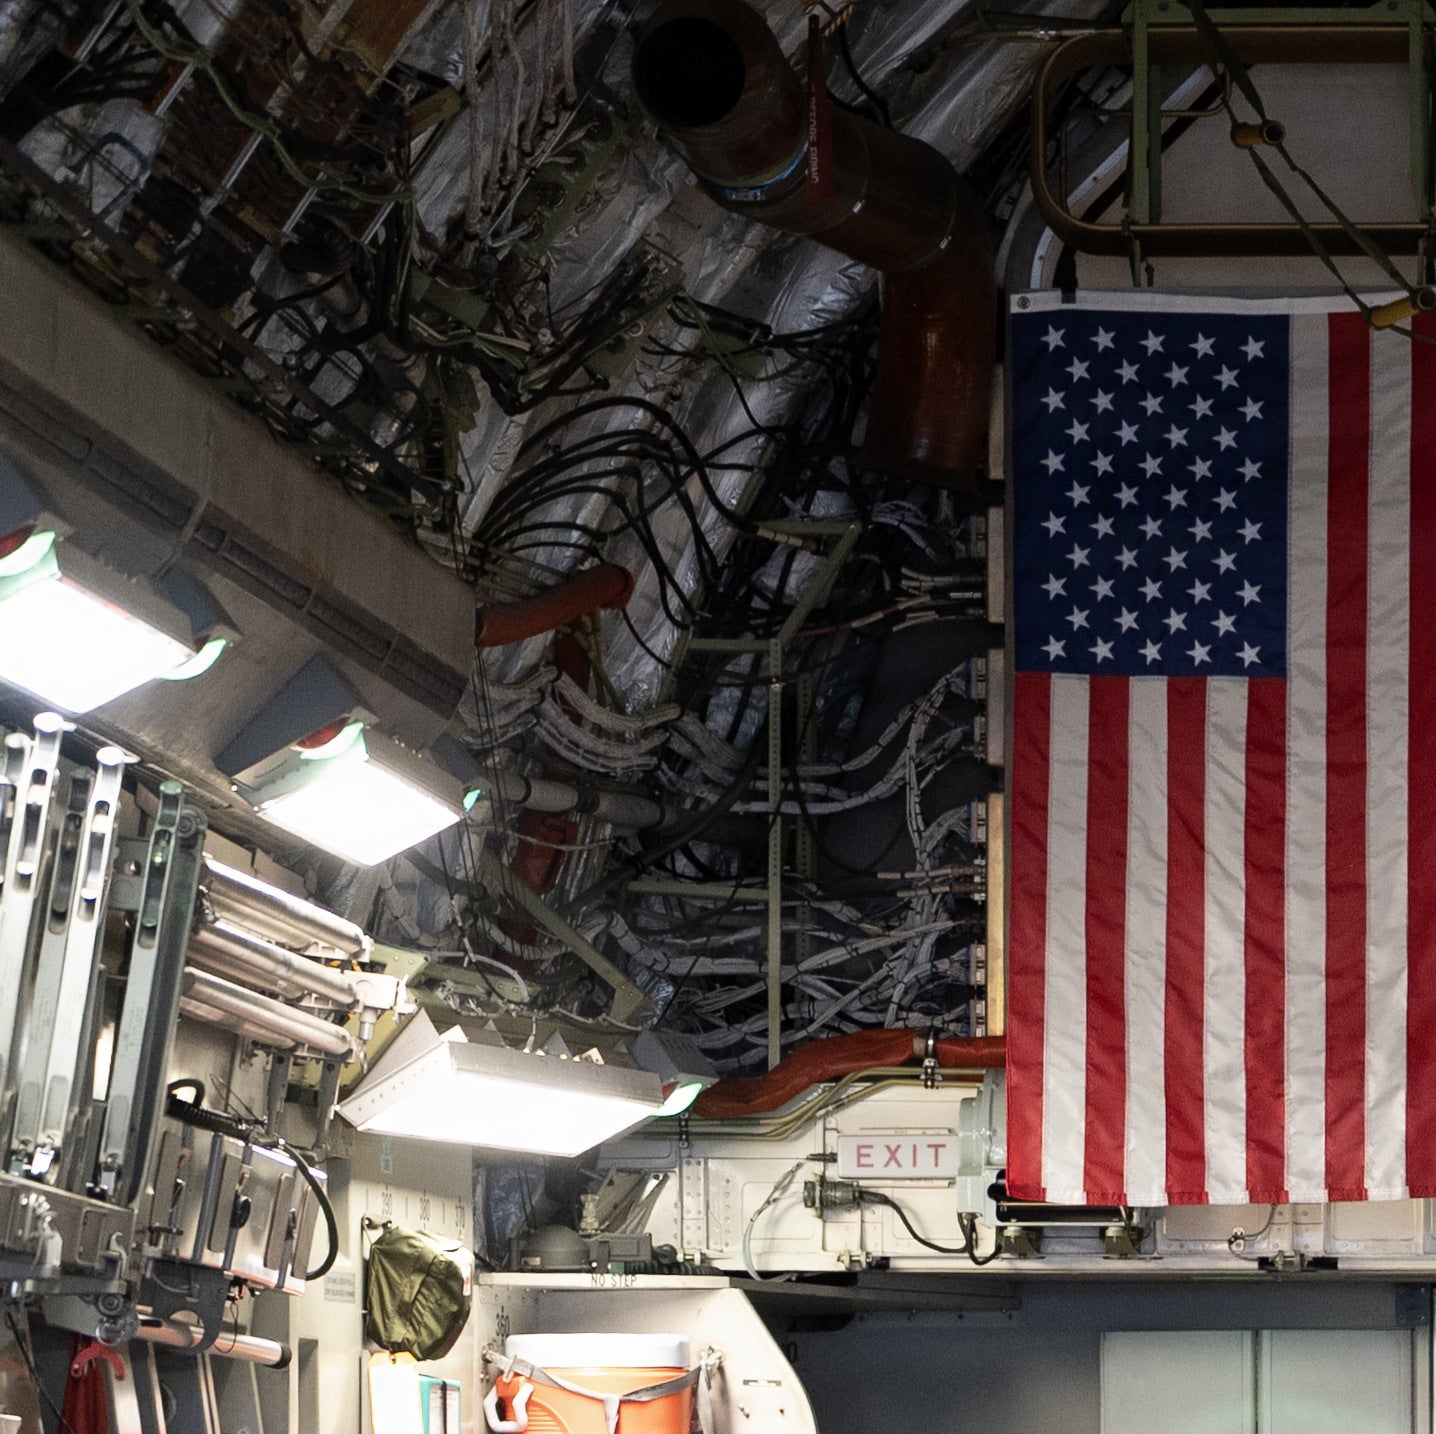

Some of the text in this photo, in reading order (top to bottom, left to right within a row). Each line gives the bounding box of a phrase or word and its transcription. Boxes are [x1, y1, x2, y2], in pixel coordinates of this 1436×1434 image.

[856, 1143, 947, 1168] EXIT
[419, 1197, 431, 1221] 380
[455, 1203, 466, 1228] 370
[592, 1272, 637, 1288] NO STEP
[496, 1312, 511, 1338] 360
